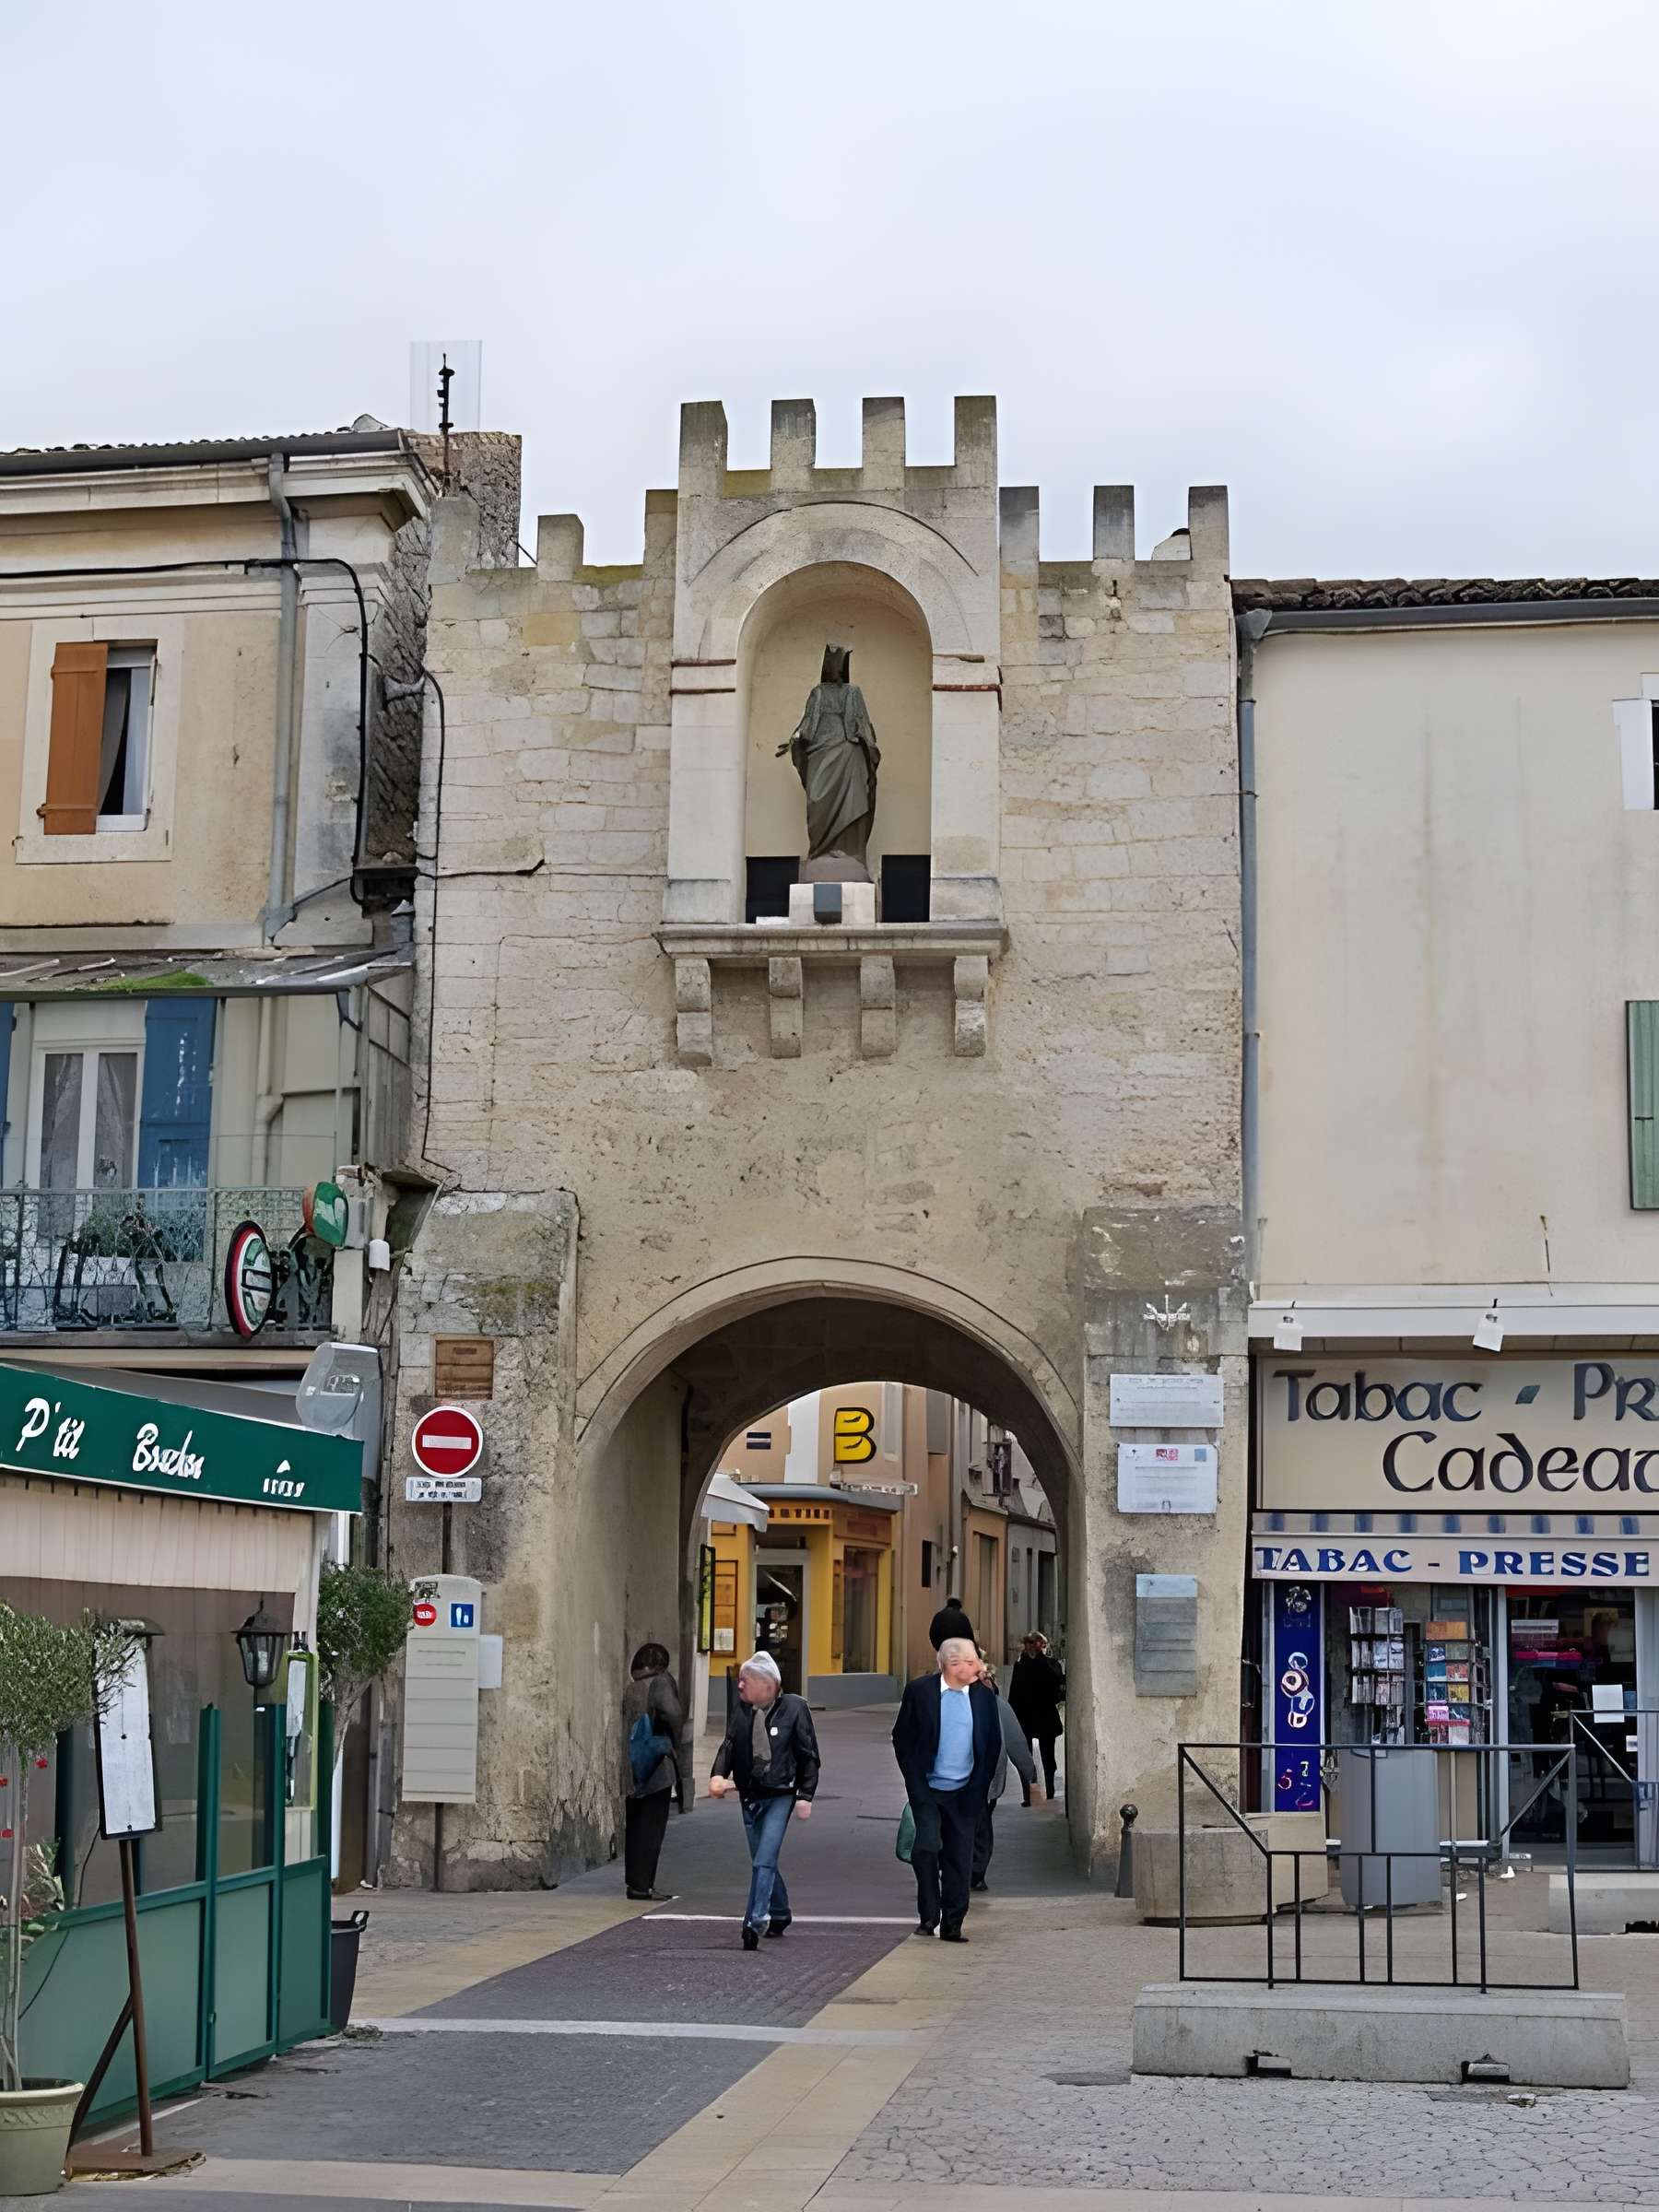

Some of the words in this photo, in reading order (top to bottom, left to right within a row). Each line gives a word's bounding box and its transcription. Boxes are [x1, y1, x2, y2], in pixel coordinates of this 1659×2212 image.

[1273, 1369, 1484, 1422] Tabac
[1254, 1547, 1413, 1573] TABAC
[1459, 1550, 1651, 1578] PRESSE
